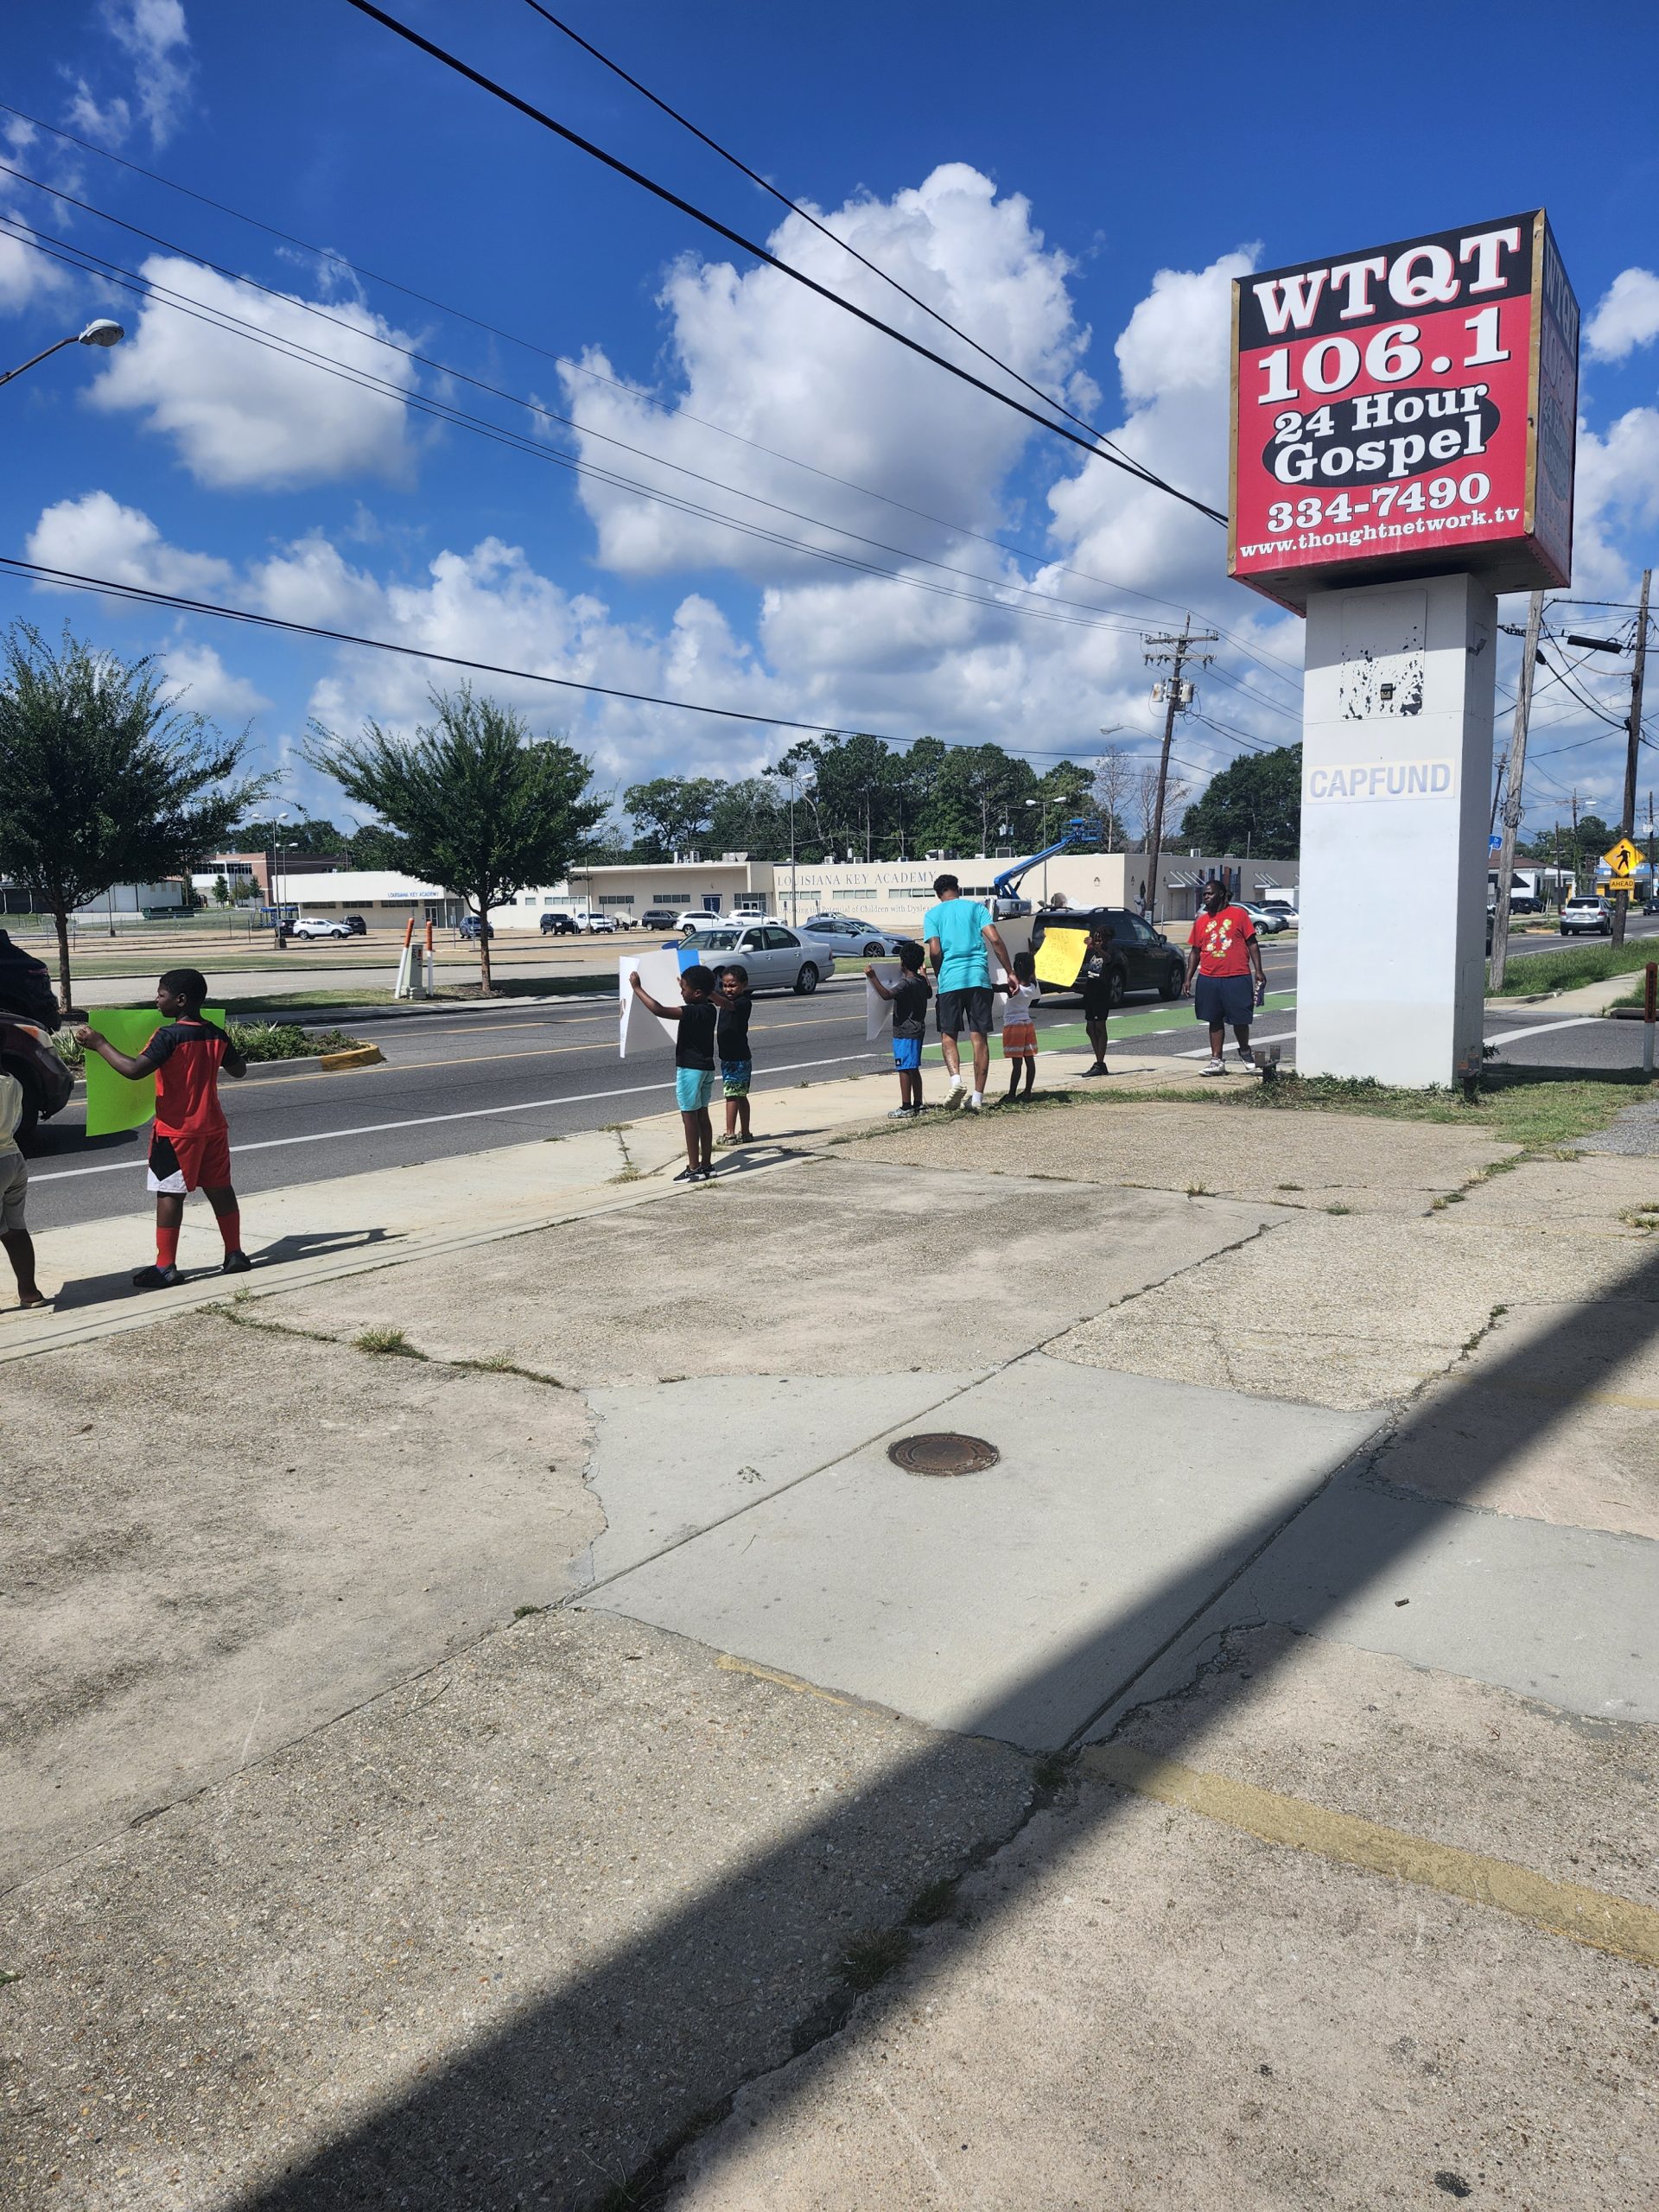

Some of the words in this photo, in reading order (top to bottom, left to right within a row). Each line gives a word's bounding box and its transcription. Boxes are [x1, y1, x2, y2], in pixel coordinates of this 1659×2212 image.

[1253, 226, 1521, 335] WTQT
[1258, 306, 1510, 405] 106.1
[1274, 406, 1335, 446] 24
[1351, 383, 1490, 431] Hour
[1274, 415, 1486, 484] Gospel
[1240, 506, 1520, 557] www.thoughtnetwork.tv
[1267, 472, 1491, 533] 334-7490
[1309, 763, 1451, 798] CAPFUND
[778, 874, 840, 886] LOUISIANA
[846, 874, 868, 884] KEY
[874, 871, 936, 884] ACADEMY
[852, 905, 859, 913] of
[860, 905, 889, 913] Children
